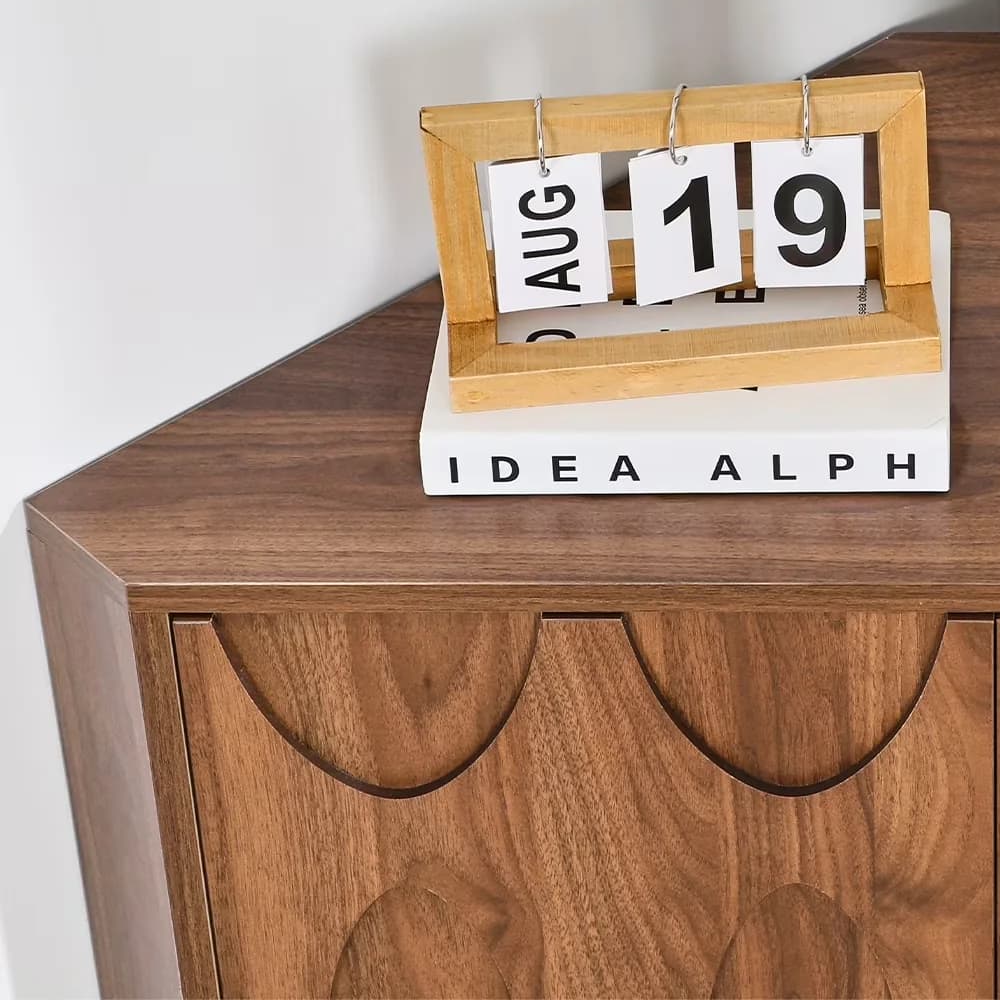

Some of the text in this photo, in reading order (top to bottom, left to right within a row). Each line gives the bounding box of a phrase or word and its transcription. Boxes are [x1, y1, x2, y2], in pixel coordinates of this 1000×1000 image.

[518, 184, 581, 293] AUG
[449, 453, 916, 484] IDEA ALPH
